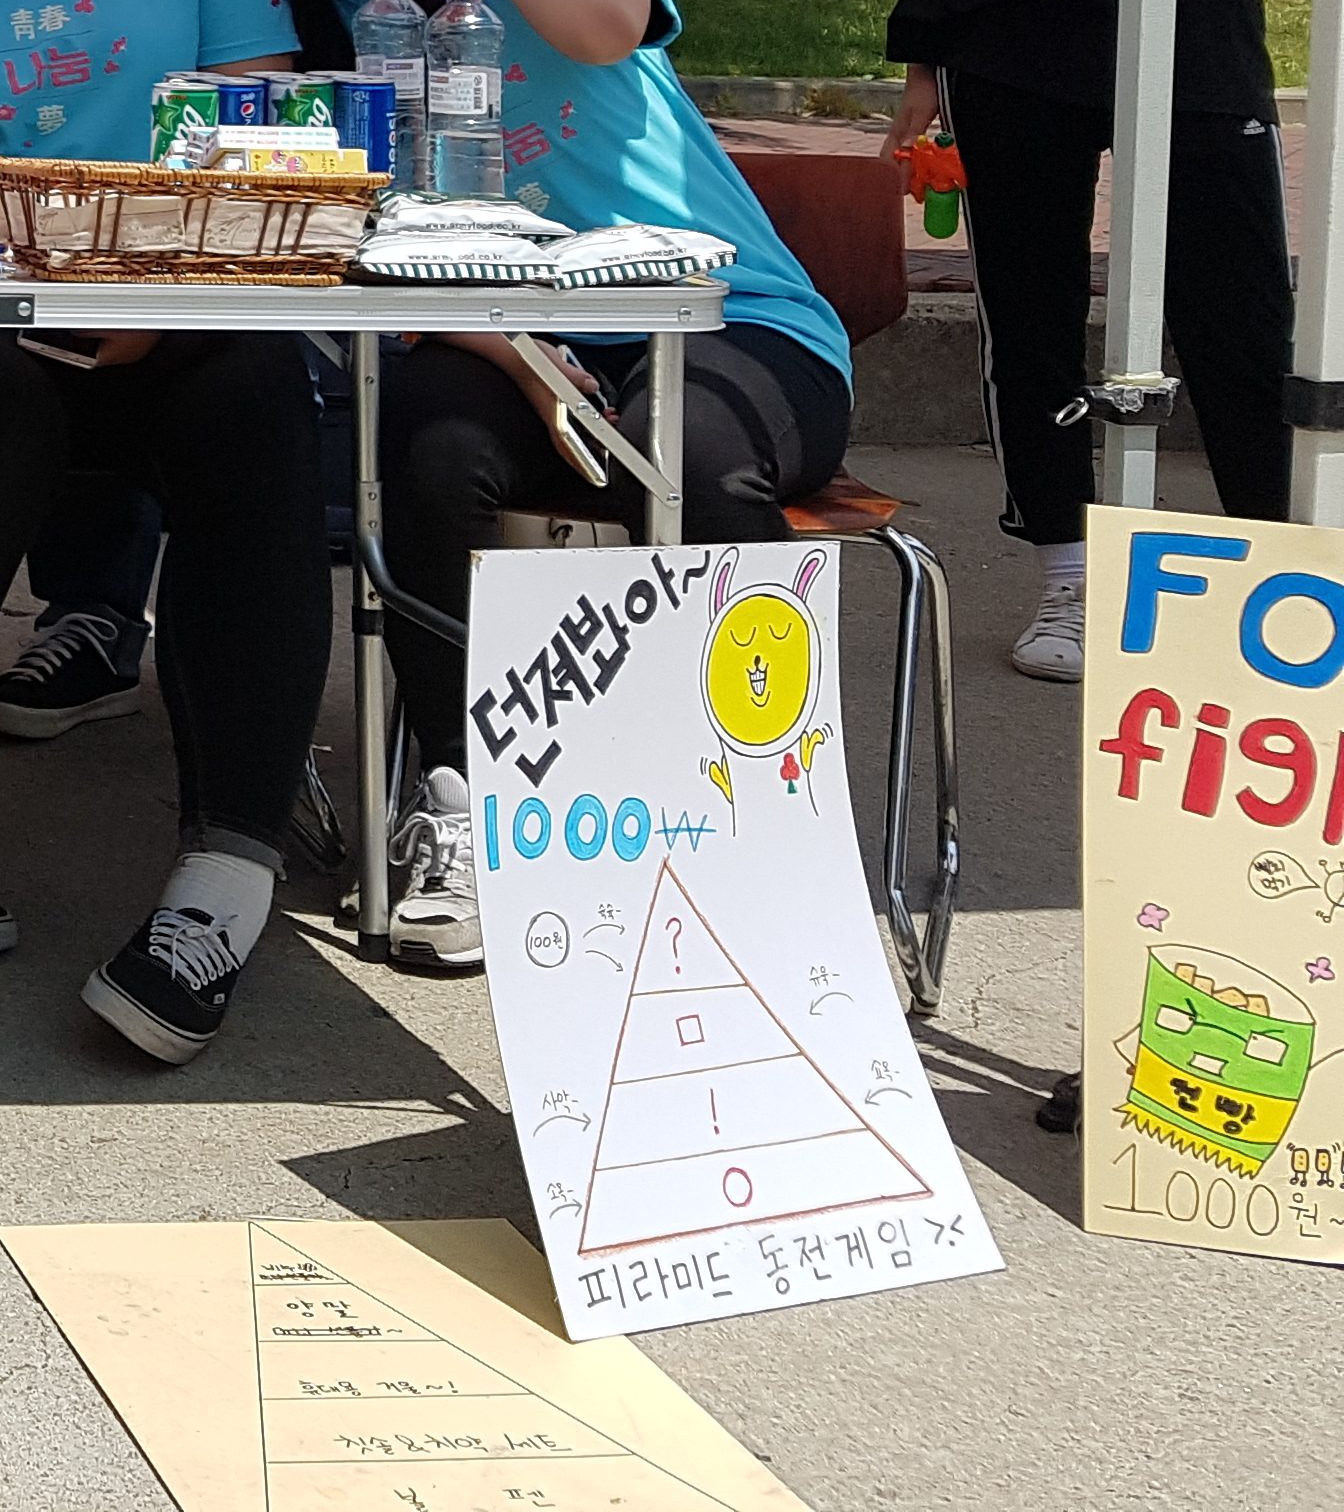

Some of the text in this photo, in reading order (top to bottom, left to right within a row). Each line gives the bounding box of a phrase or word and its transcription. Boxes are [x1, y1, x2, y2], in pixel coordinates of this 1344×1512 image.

[3, 47, 91, 96] 나눔
[529, 931, 565, 950] 100원
[578, 1251, 733, 1309] 피라미드
[757, 1219, 913, 1296] 동전게임
